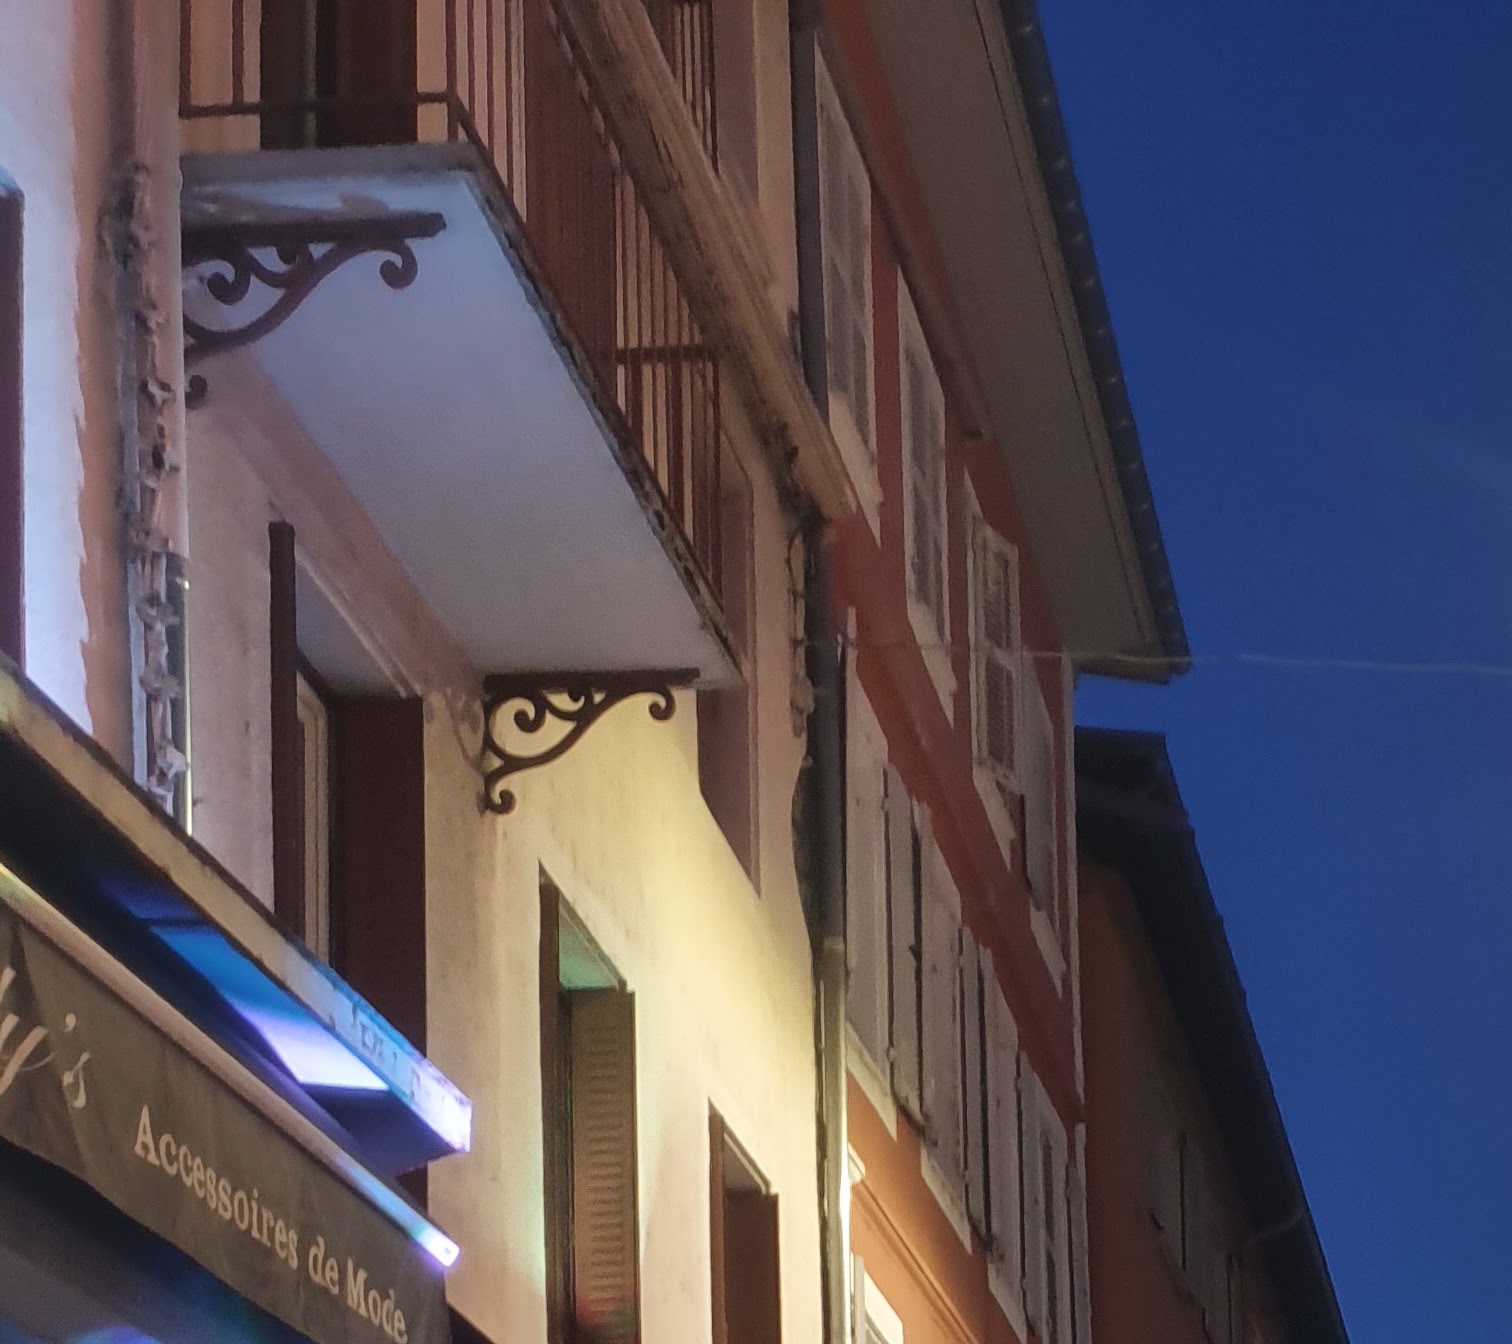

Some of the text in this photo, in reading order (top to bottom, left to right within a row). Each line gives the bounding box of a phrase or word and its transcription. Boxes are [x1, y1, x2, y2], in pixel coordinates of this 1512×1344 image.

[133, 1103, 408, 1344] Accessoires de Mode
